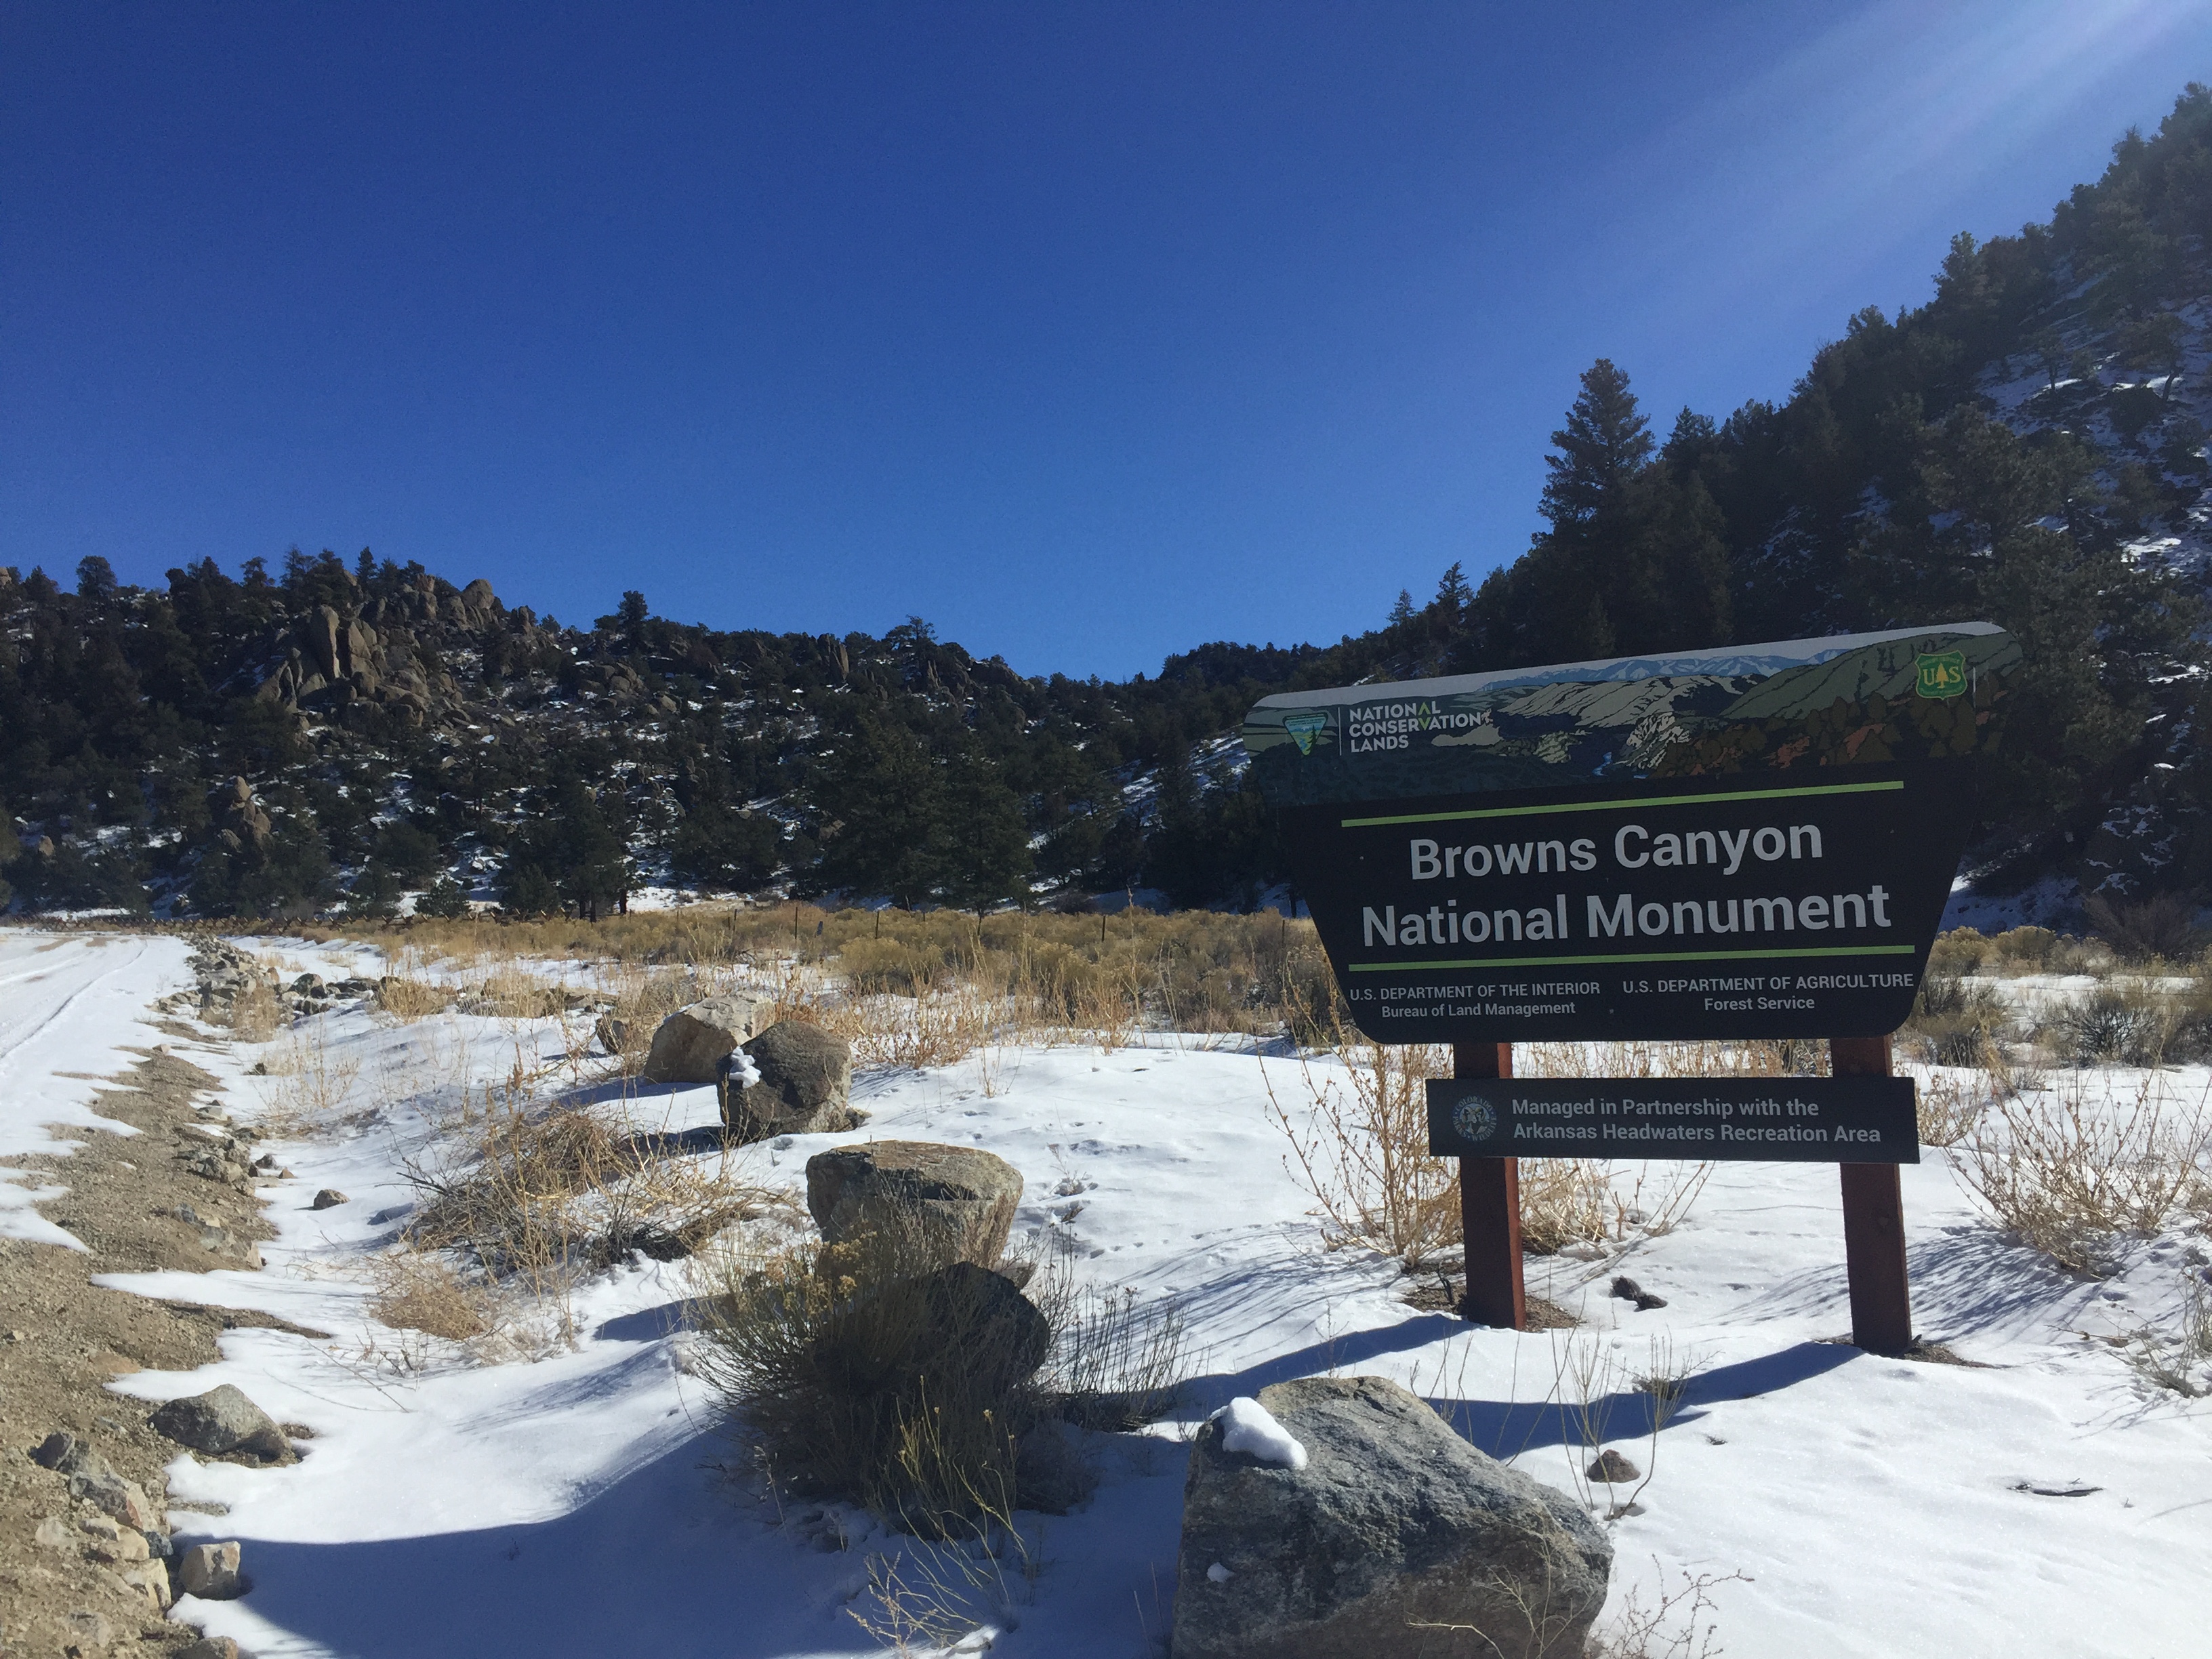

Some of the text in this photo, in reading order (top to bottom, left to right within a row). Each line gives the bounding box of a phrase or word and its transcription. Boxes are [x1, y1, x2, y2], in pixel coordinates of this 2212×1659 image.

[1349, 700, 1441, 722] NATIONAL
[1349, 712, 1481, 737] CONSERVATION
[1351, 734, 1409, 753] LANDS
[1410, 824, 1822, 880] Browns Canyon
[1362, 884, 1891, 947] National Monument
[1350, 981, 1601, 1001] U.S. DEPARTMENT OF THE INTERIOR
[1622, 973, 1914, 994] U.S. DEPARTMENT OF AGRICULTURE
[1382, 1002, 1576, 1018] Bureau of Land Management
[1704, 995, 1815, 1011] Forest Service
[1512, 1098, 1819, 1120] Managed in Partnership with the
[1513, 1122, 1881, 1143] Arkansas Headwaters Recreation Area
